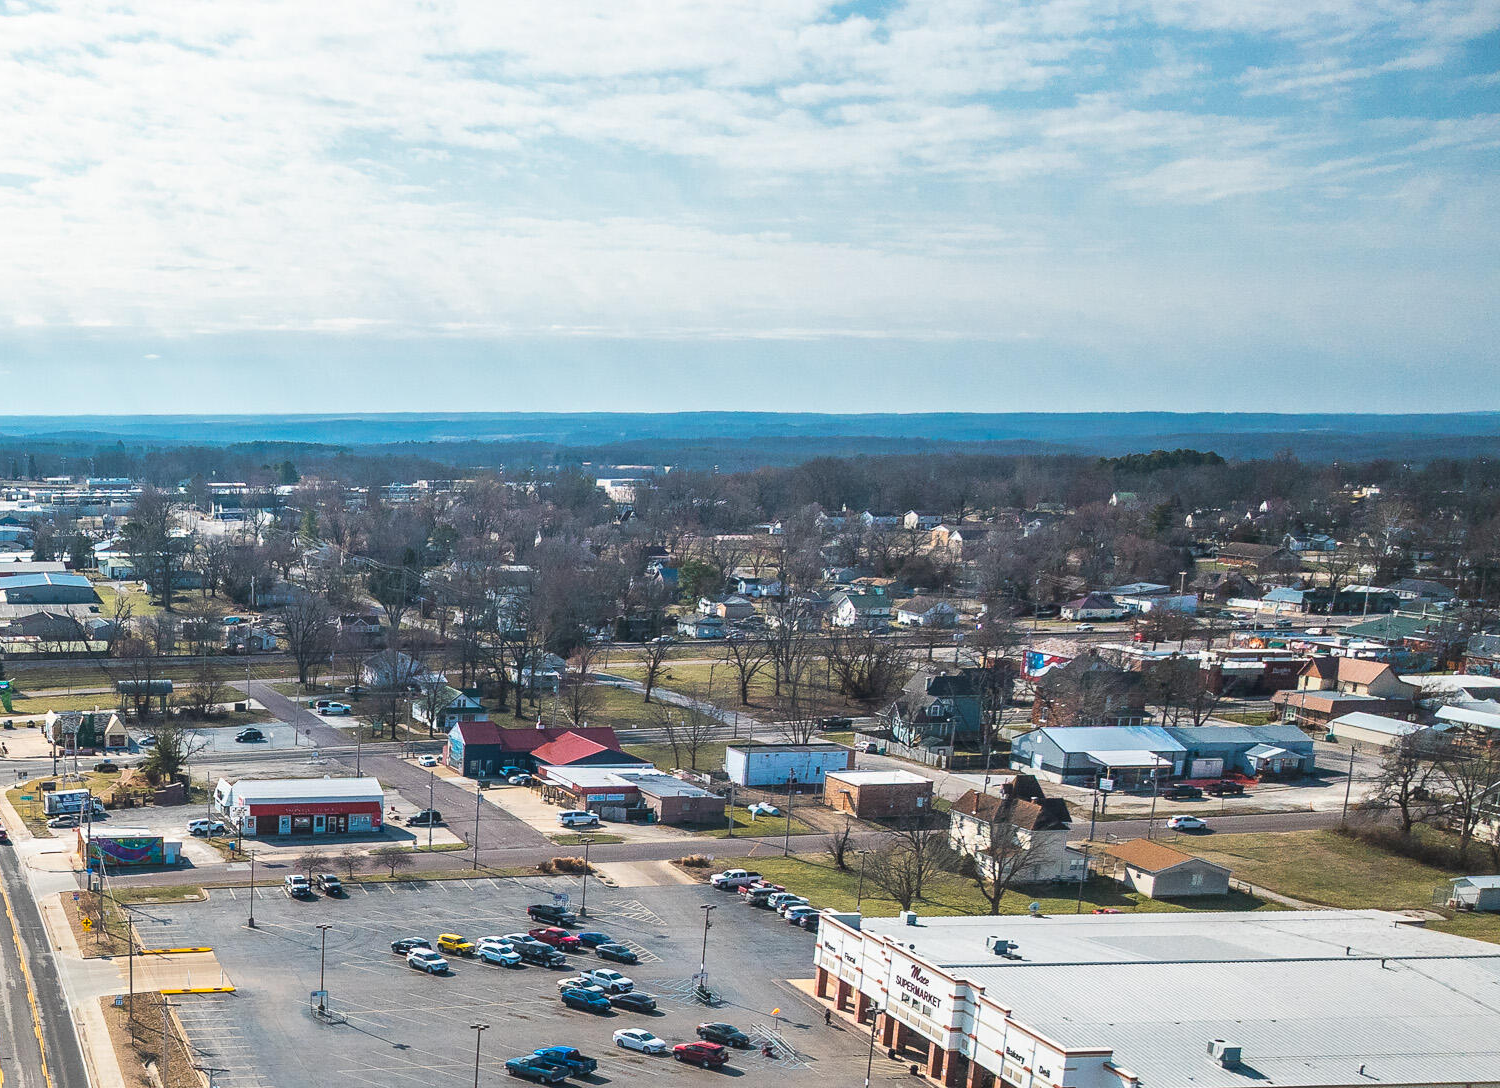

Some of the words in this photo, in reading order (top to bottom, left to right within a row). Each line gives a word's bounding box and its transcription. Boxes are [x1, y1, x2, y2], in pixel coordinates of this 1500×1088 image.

[895, 974, 942, 1009] SUPERMARKET
[1005, 1046, 1025, 1065] Bakery
[1038, 1065, 1051, 1079] Deli
